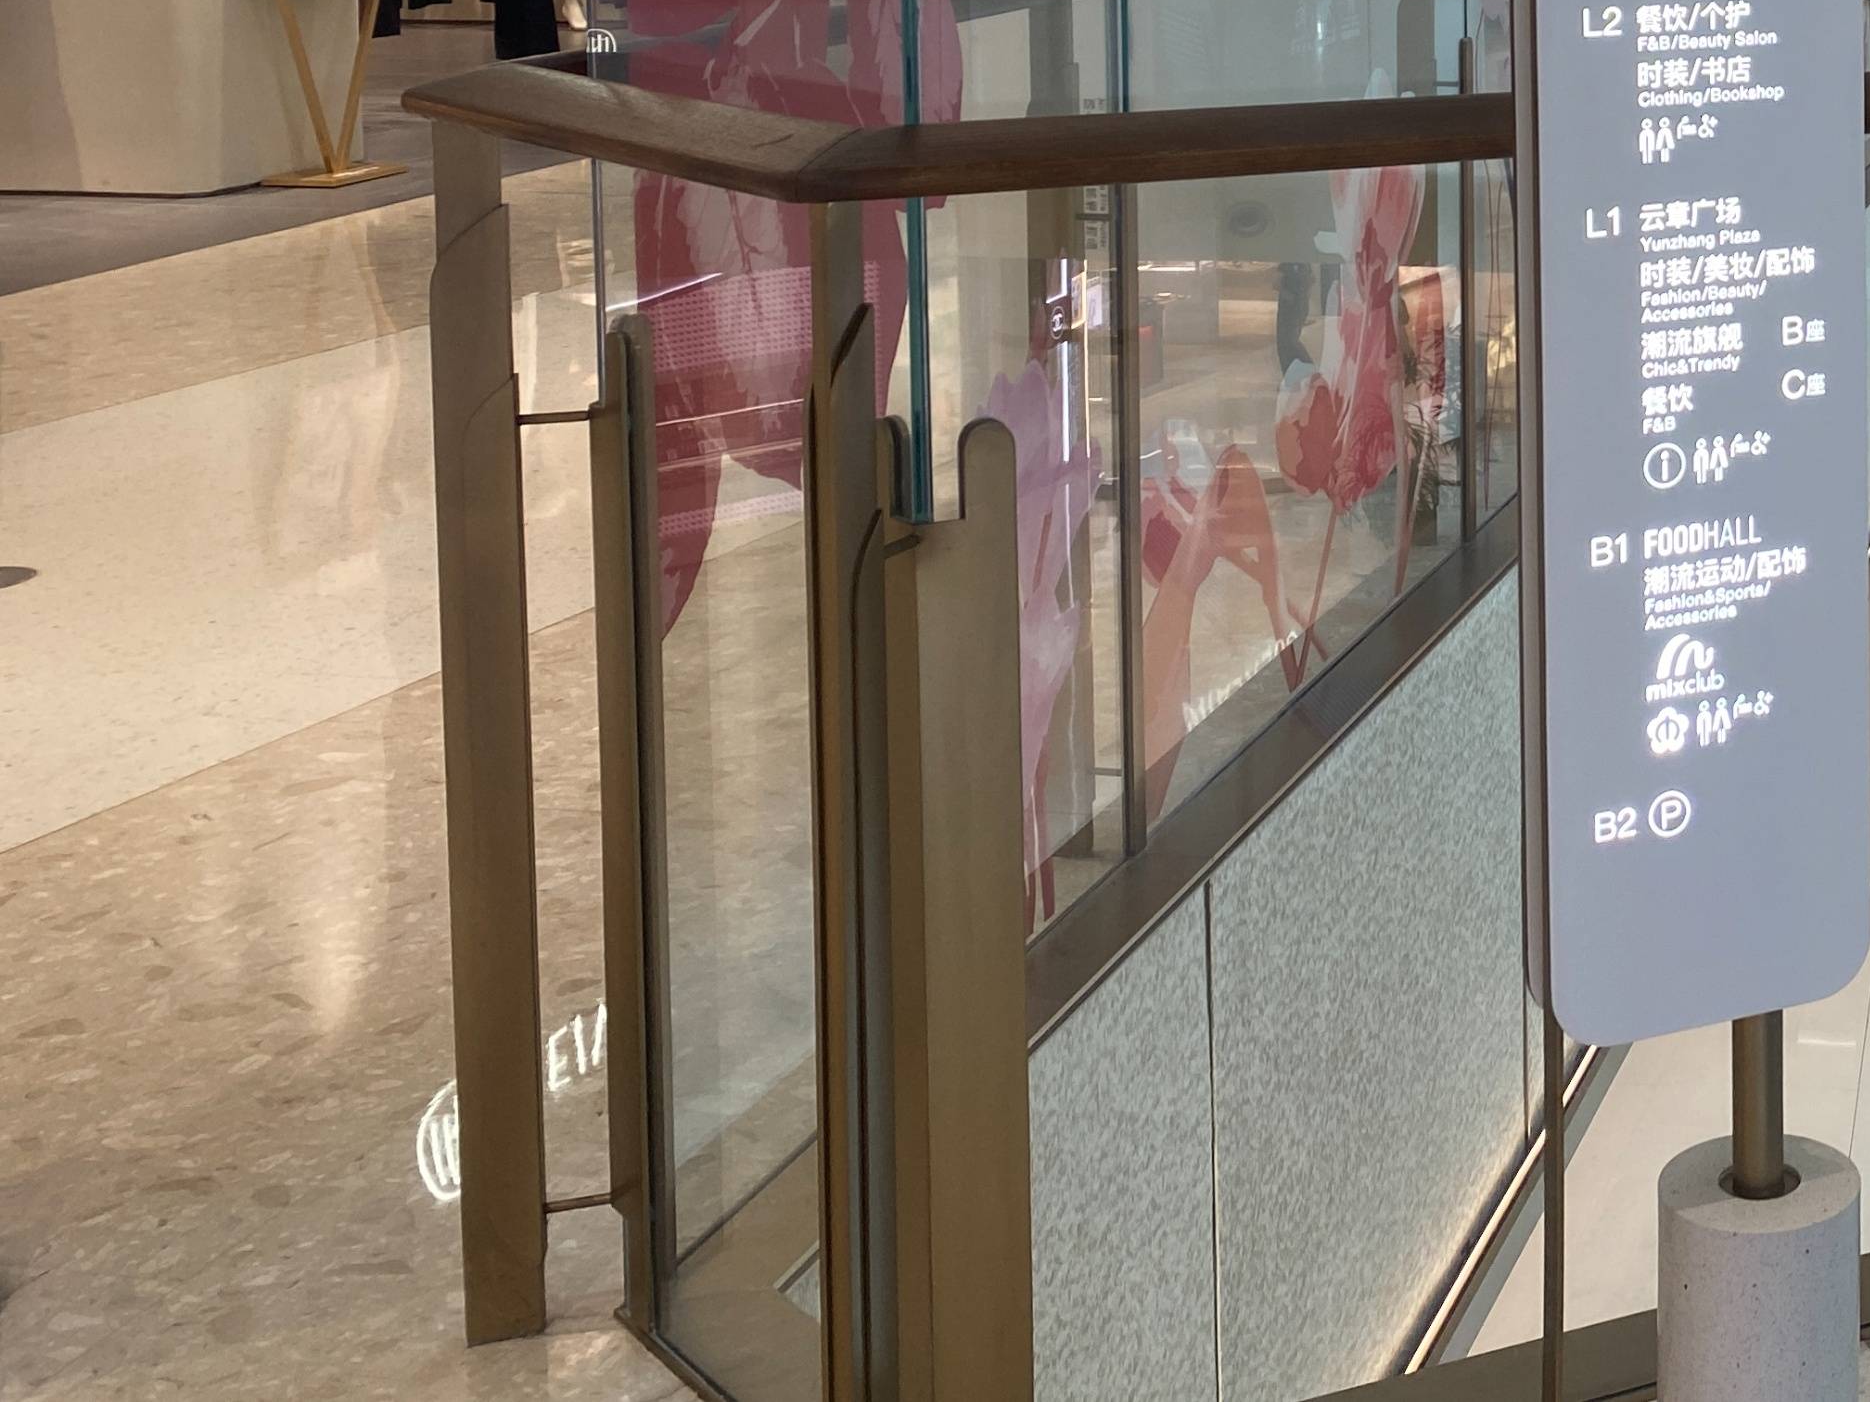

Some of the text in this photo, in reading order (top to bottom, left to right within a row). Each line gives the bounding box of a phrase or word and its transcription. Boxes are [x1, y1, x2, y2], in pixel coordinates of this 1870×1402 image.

[1582, 0, 1754, 39] L2 餐饮/个护
[1637, 29, 1778, 52] F&B/Beauty Salon
[1637, 54, 1753, 89] 时装/书店
[1637, 84, 1786, 109] Clothing/Bookshop
[1585, 197, 1742, 239] L1 云章广场
[1640, 228, 1762, 254] Yunzhang Plaza
[1641, 279, 1768, 308] Fashion/Beauty/
[1641, 301, 1734, 324] Accessories
[1641, 322, 1745, 361] 潮流旗舰
[1642, 354, 1741, 380] Chic&Trendy
[1642, 382, 1695, 417] 餐饮
[1642, 415, 1677, 435] F&B
[1589, 514, 1764, 568] B1 FOODHALL
[1644, 545, 1808, 596] 潮流运动/配饰
[1645, 580, 1772, 615] Fashion&Sports/
[1645, 603, 1739, 631] Accessories
[1645, 668, 1726, 703] mixclub
[1594, 806, 1639, 845] B2
